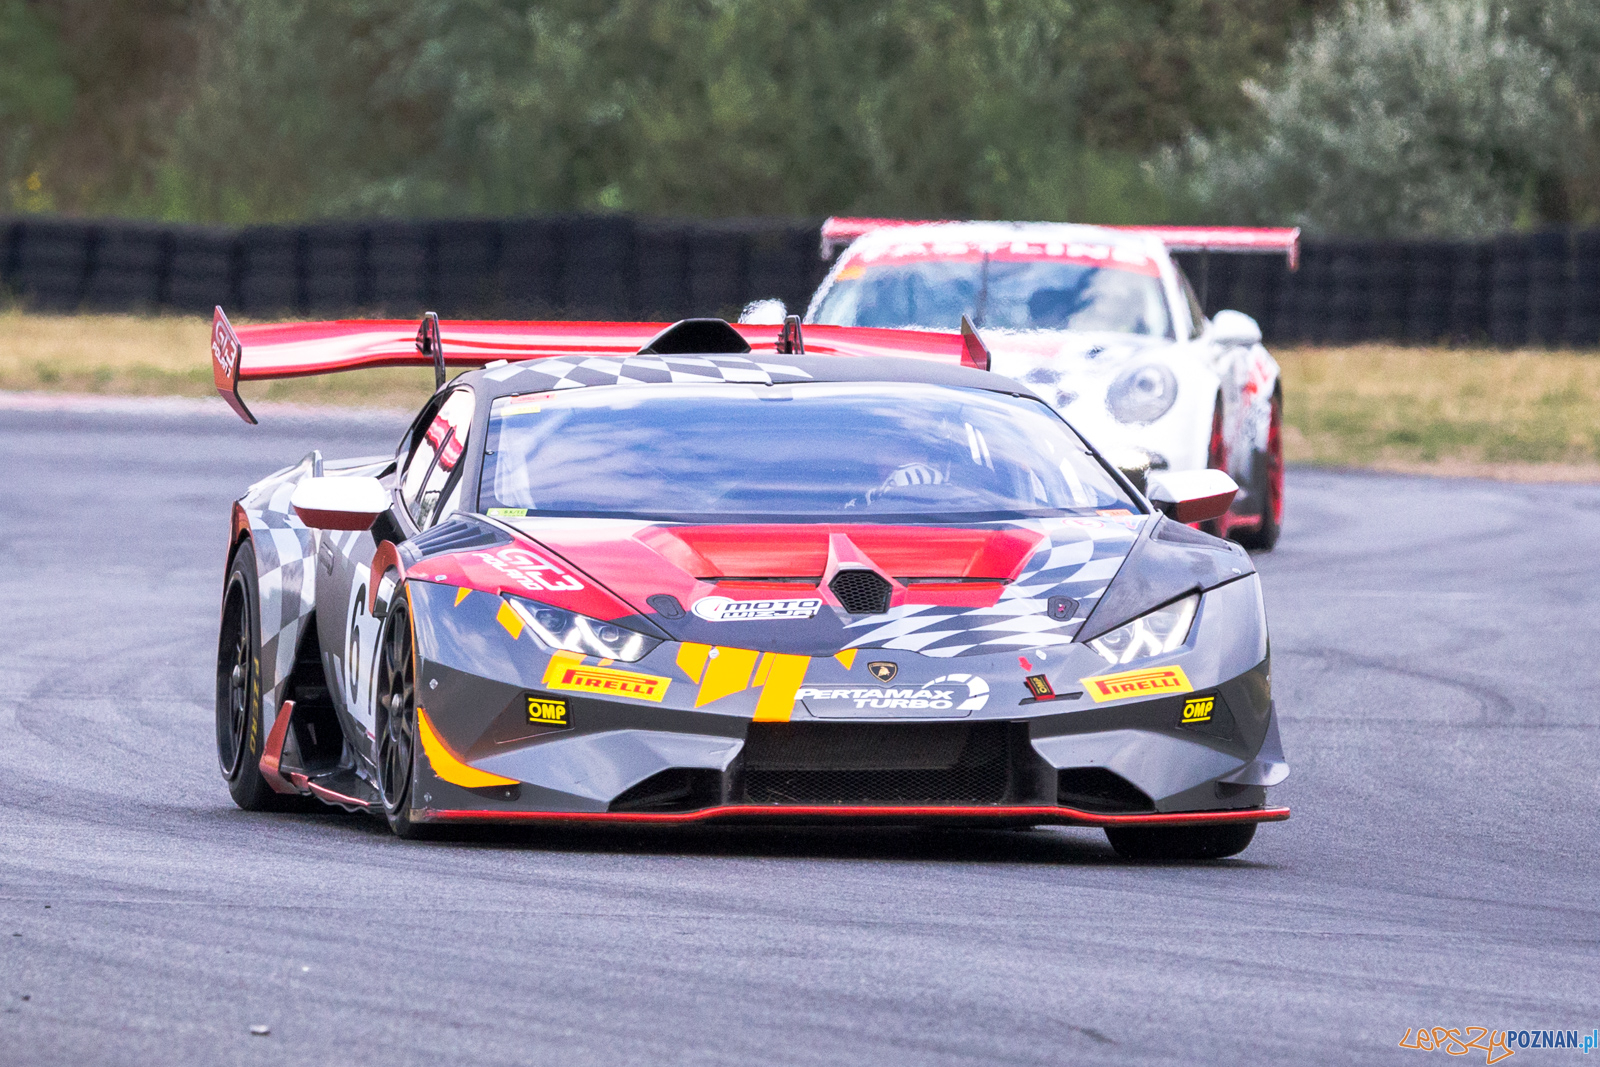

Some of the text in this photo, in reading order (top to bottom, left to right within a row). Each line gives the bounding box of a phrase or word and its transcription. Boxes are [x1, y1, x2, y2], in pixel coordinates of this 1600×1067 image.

[215, 320, 237, 368] GT3
[211, 340, 232, 379] POLAND
[472, 552, 545, 591] POLAND
[497, 548, 585, 592] GT3
[724, 600, 820, 611] MOTO
[561, 668, 659, 695] PIRELLI
[1032, 676, 1048, 694] OMP
[1095, 671, 1181, 696] PIRELLI
[794, 687, 955, 701] PERTAMAX
[853, 698, 954, 710] TURBO
[528, 702, 566, 720] OMP
[1183, 700, 1214, 719] OMP
